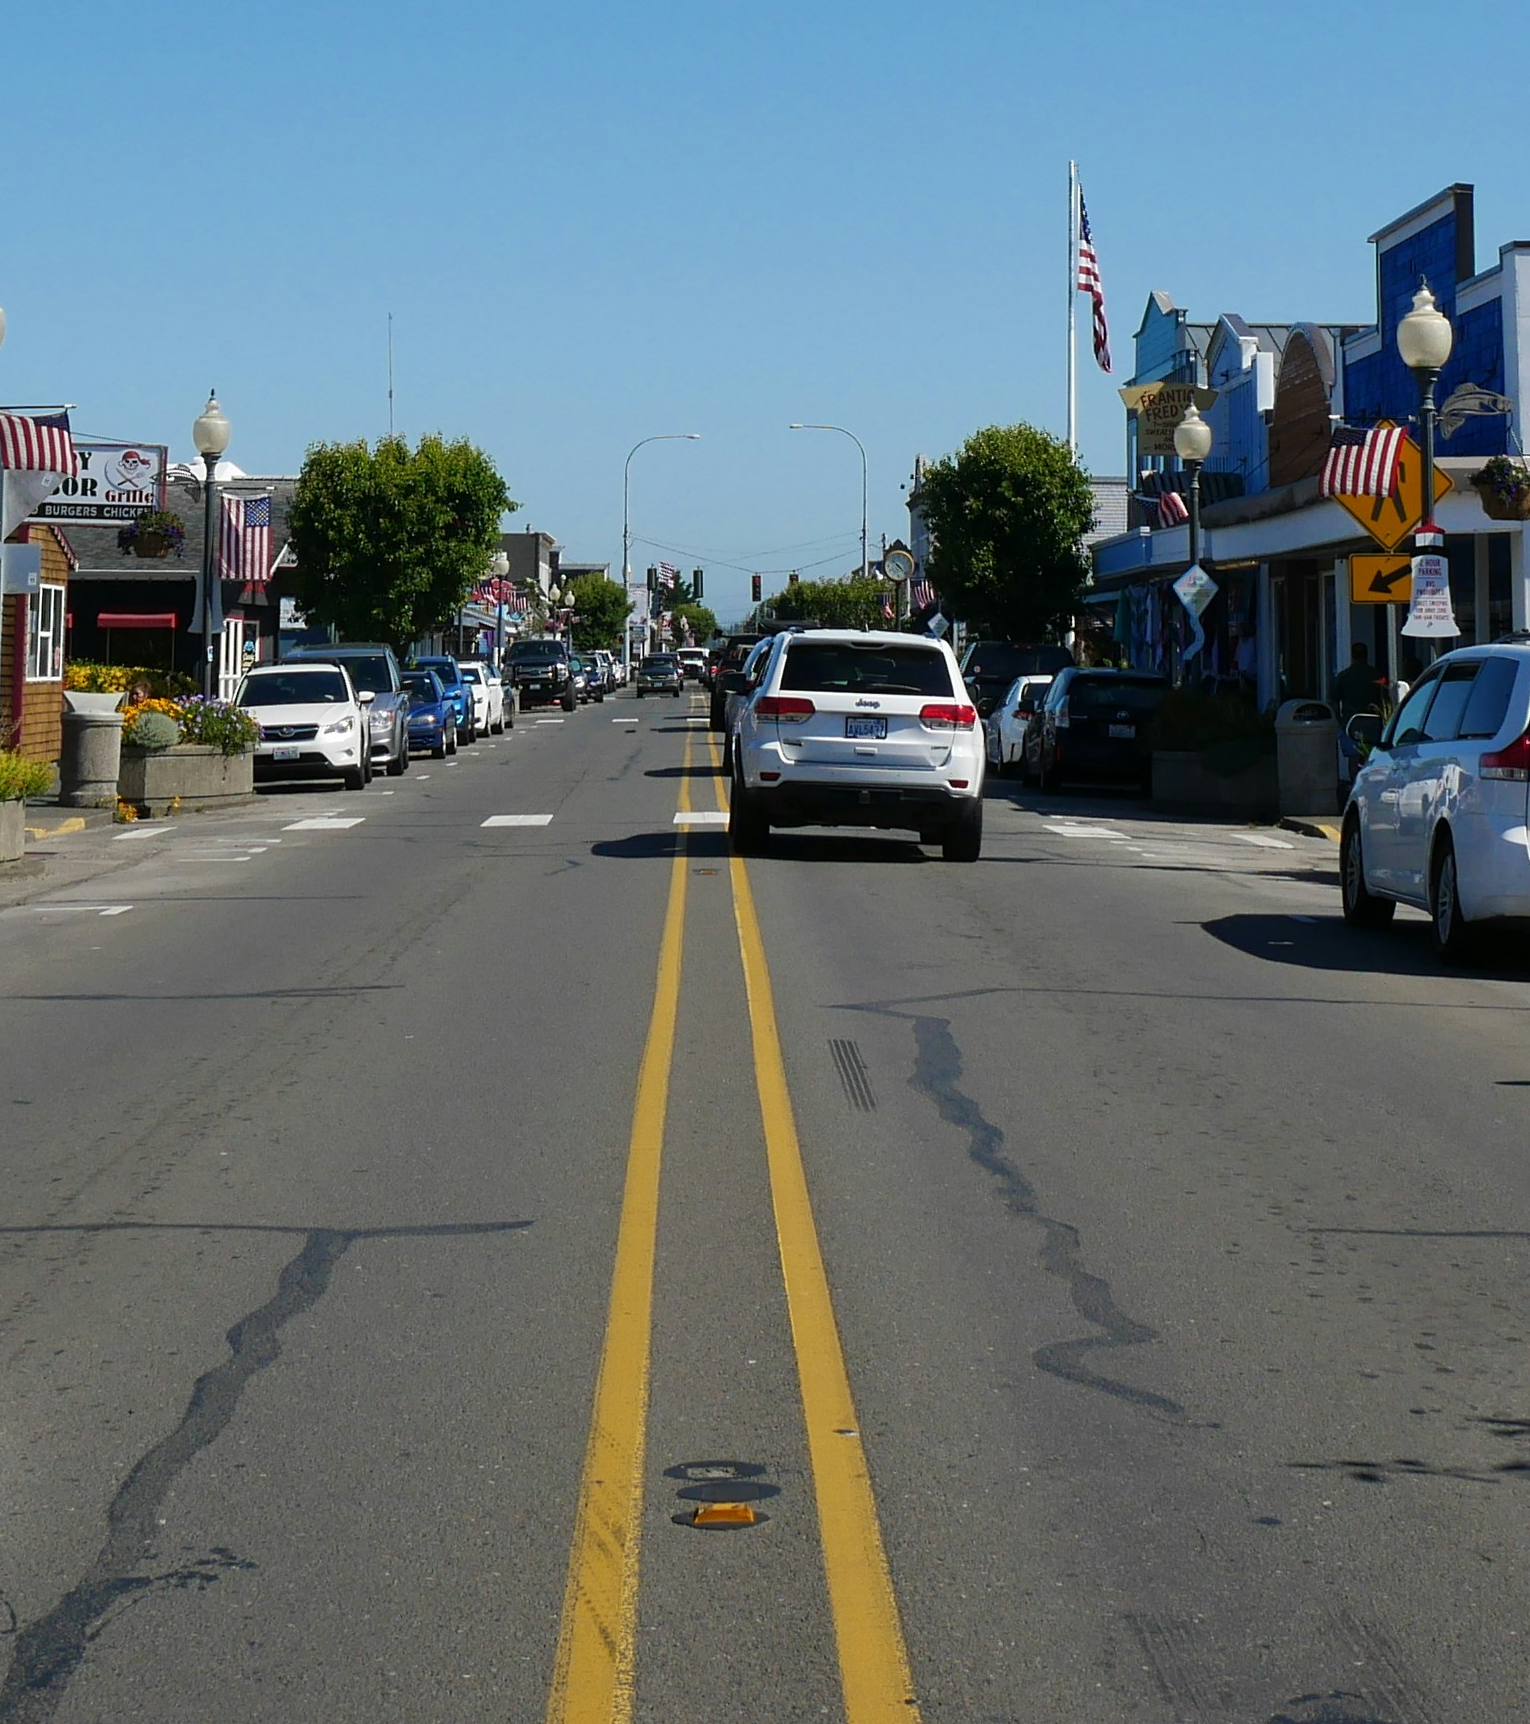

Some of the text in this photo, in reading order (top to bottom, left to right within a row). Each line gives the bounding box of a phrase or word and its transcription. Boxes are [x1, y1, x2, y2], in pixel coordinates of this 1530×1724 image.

[1140, 389, 1195, 408] FRANTIC
[105, 490, 154, 503] Grille
[45, 506, 98, 516] BURGERS
[1418, 568, 1442, 576] PARKING
[855, 699, 880, 709] Jeep
